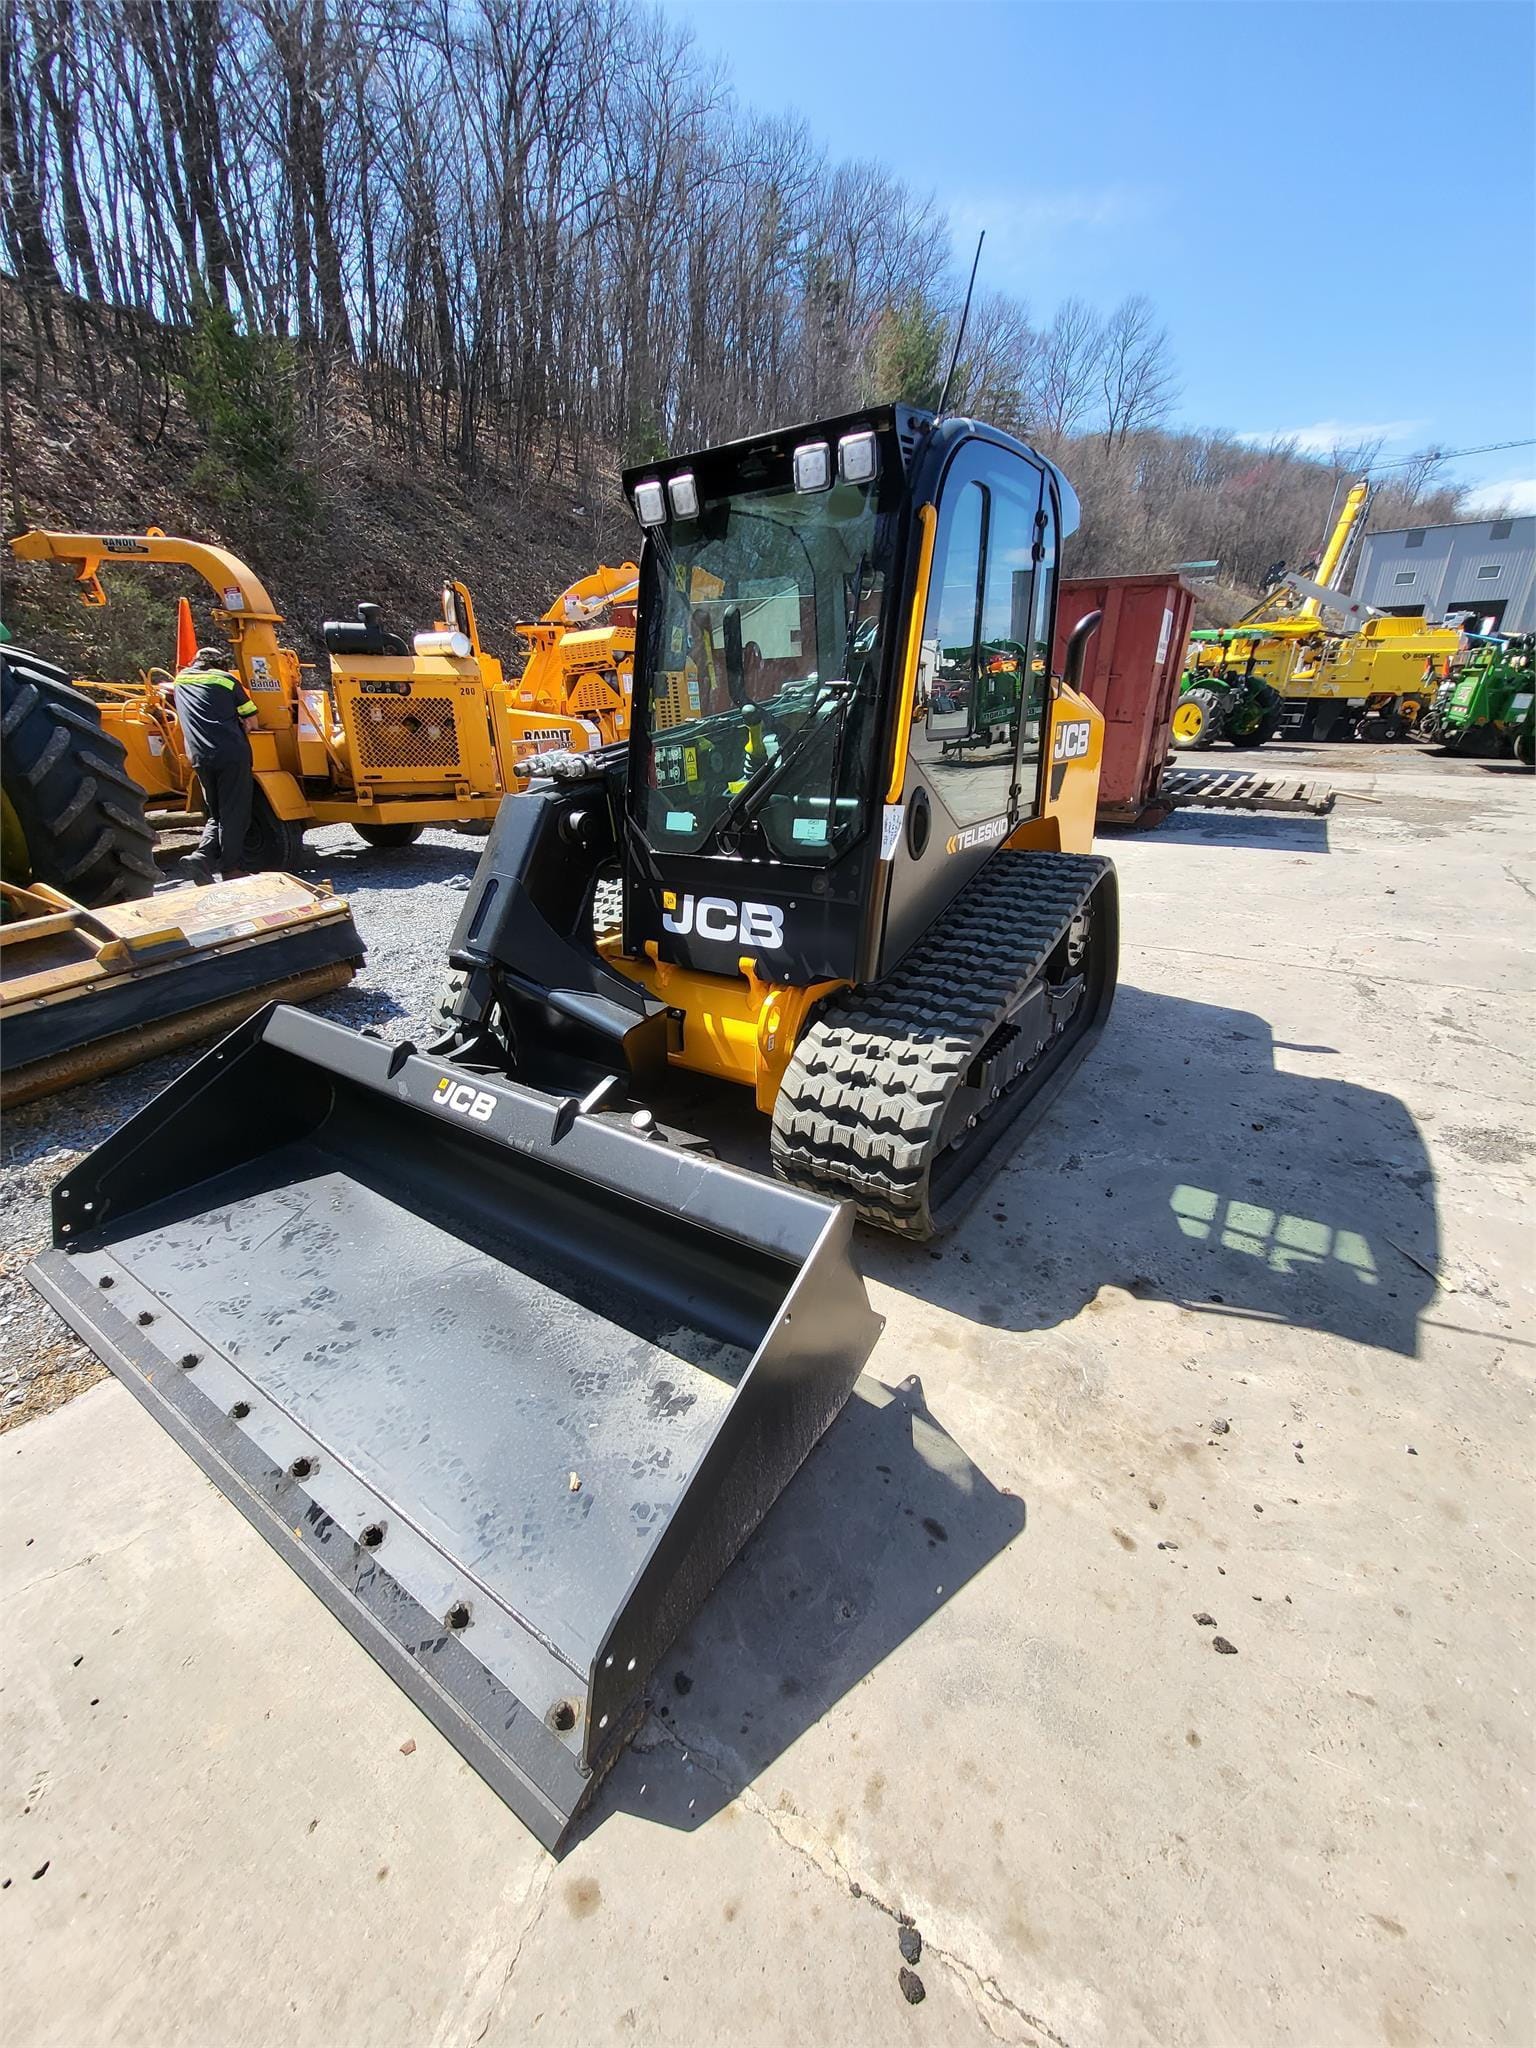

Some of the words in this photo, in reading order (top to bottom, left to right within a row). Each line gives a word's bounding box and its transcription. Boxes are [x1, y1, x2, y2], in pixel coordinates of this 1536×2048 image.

[251, 679, 281, 688] Bandit
[461, 687, 475, 696] 200
[523, 730, 571, 742] BANDIT
[1055, 723, 1090, 759] JCB
[957, 817, 1008, 851] TELESKID
[663, 894, 784, 949] JCB
[432, 1080, 498, 1122] JCB
